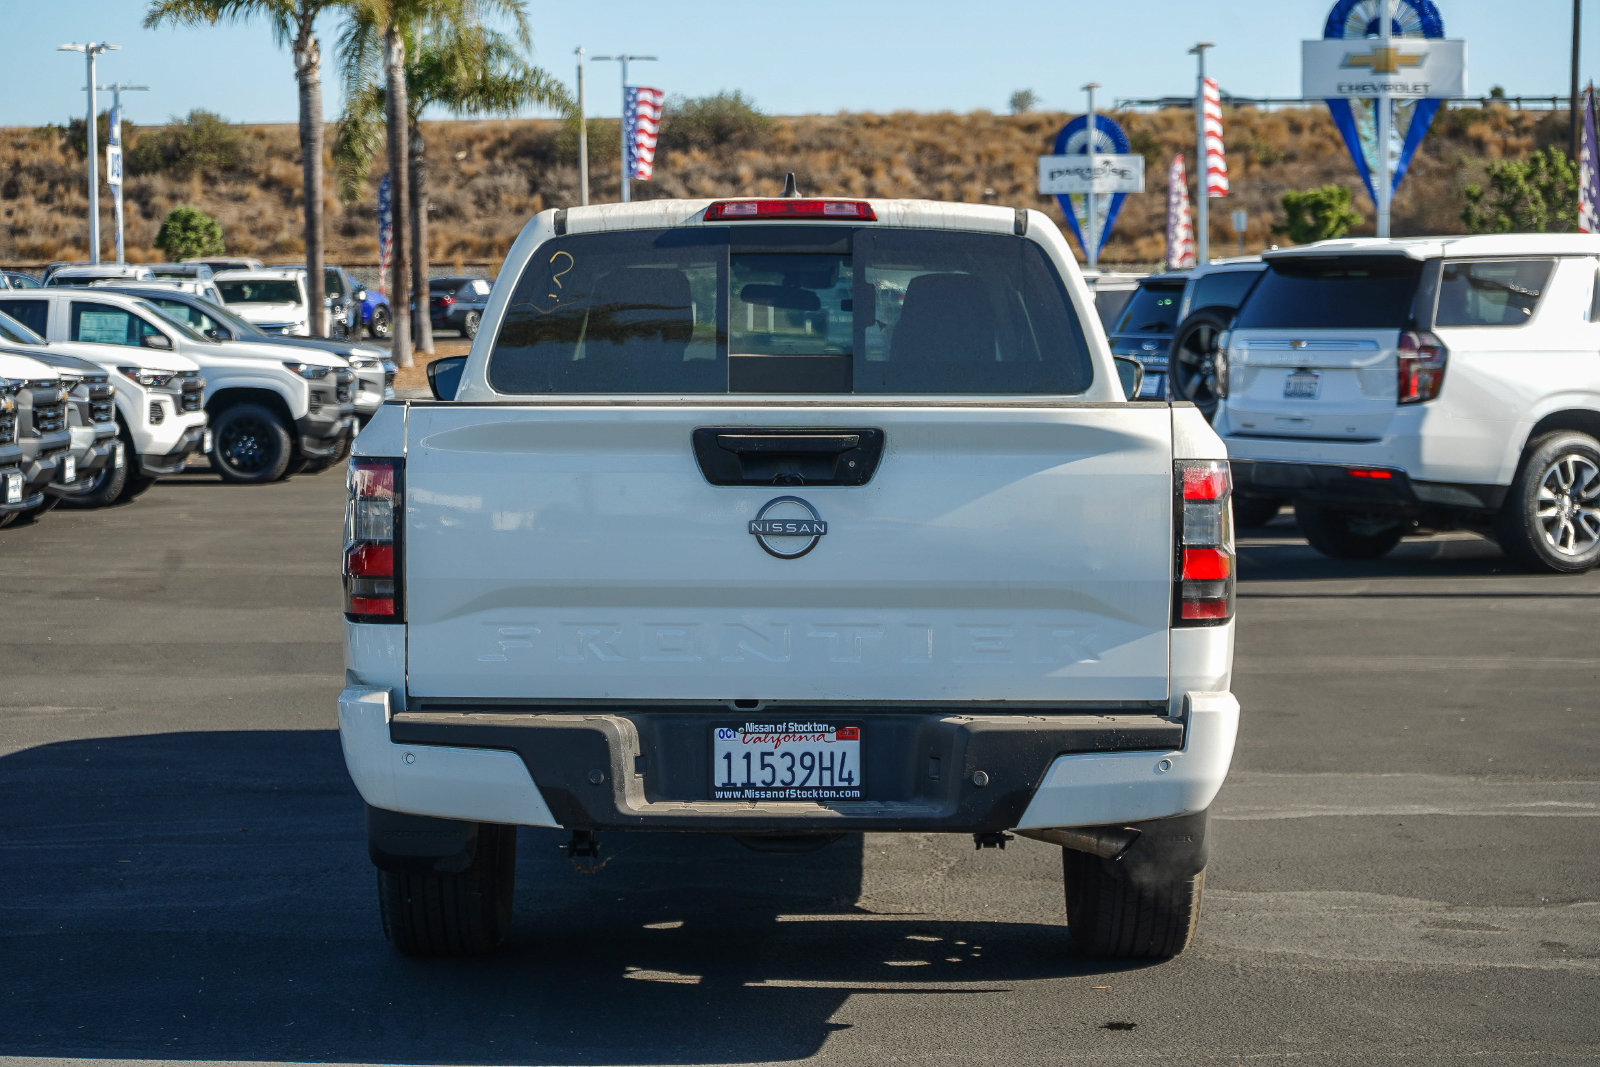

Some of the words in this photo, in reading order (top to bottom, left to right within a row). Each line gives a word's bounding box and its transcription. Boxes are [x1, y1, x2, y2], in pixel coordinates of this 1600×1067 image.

[1336, 82, 1432, 94] CHEVROLET
[751, 522, 825, 533] NISSAN
[477, 621, 1100, 664] FRONTIER
[745, 722, 775, 733] Nissan
[777, 722, 787, 733] of
[788, 721, 829, 732] Stockton
[718, 729, 738, 740] OCT
[742, 732, 832, 749] California
[721, 751, 855, 787] 11539H4
[715, 788, 861, 799] www.NissanofStockton.com
